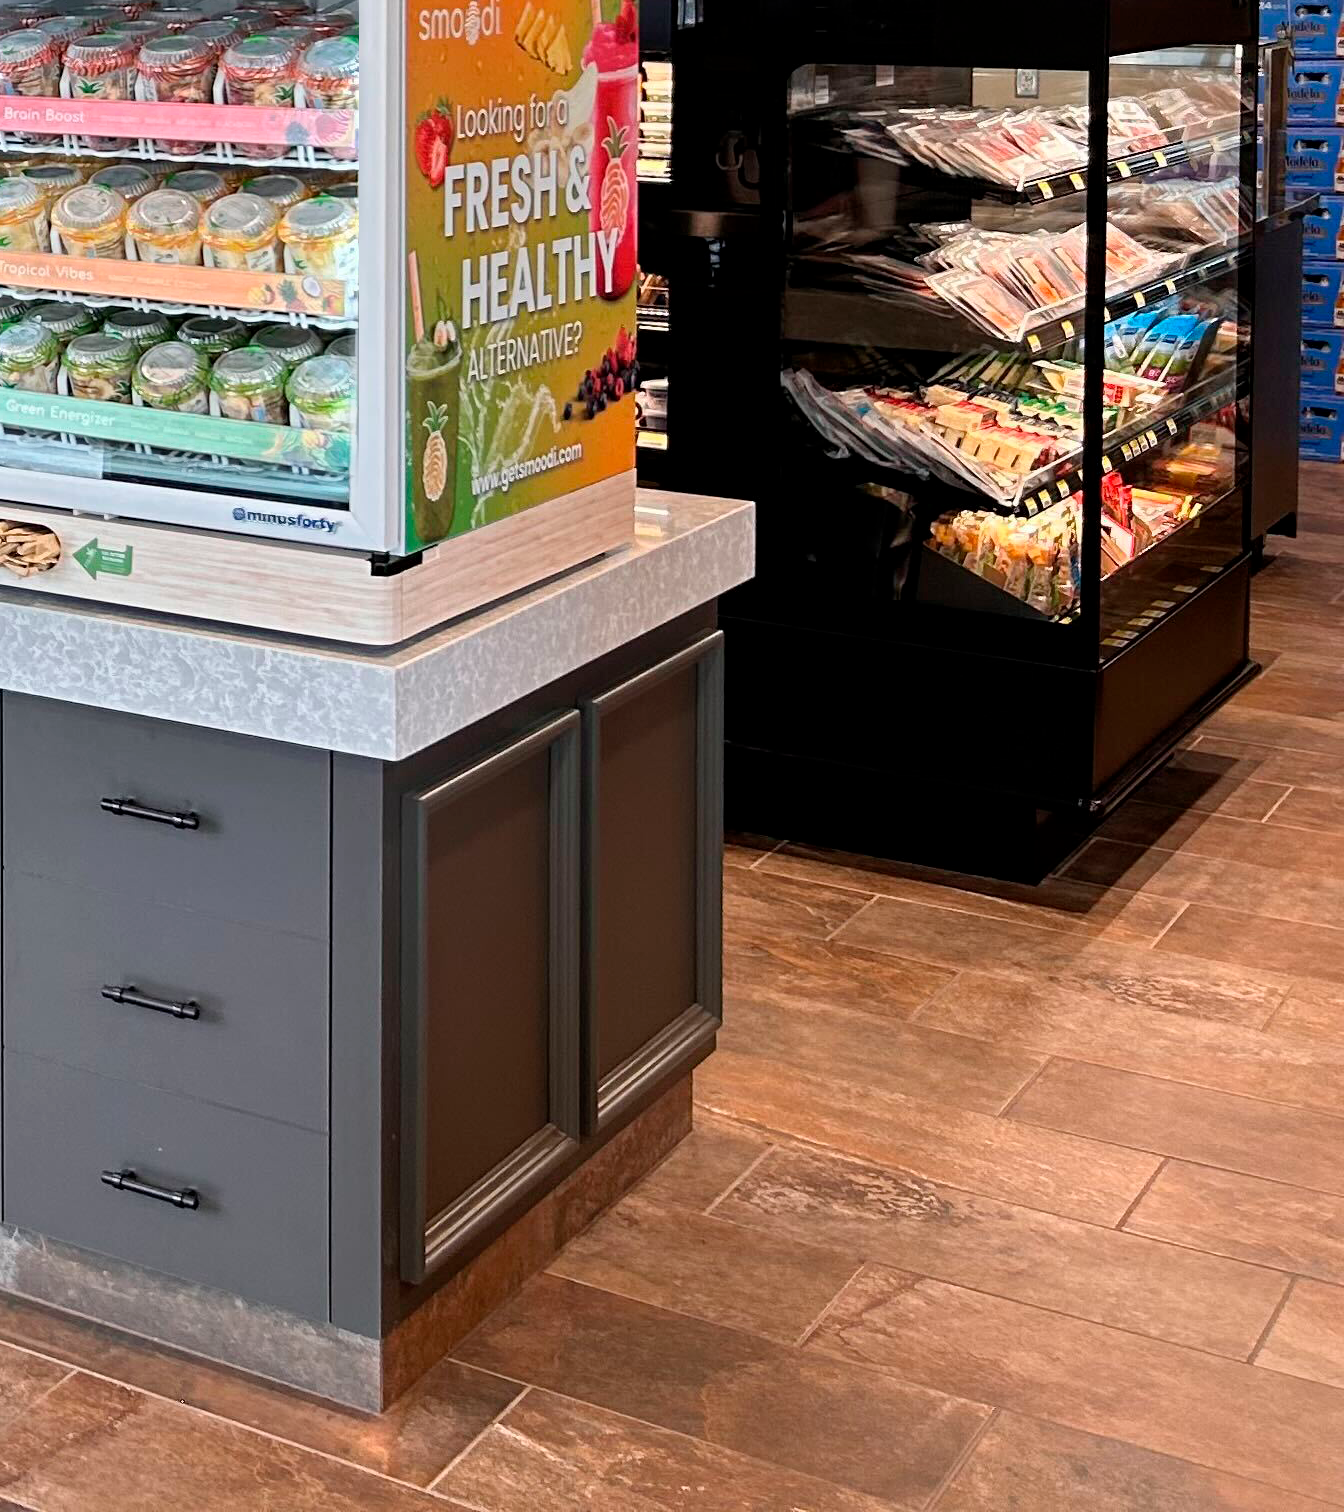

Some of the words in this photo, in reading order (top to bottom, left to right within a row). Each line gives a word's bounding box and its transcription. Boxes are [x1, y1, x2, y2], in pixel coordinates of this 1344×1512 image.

[3, 106, 41, 121] Brain
[45, 108, 85, 124] Boost
[456, 97, 525, 143] Looking
[529, 93, 554, 129] for
[555, 98, 569, 126] a
[443, 149, 558, 238] FRESH
[565, 144, 592, 214] &
[55, 263, 94, 282] Vibes
[461, 229, 621, 330] HEALTHY
[466, 320, 583, 384] ALTERNATIVE?
[5, 398, 45, 418] Green
[49, 404, 116, 427] Energizer
[471, 442, 583, 496] www.getsmoodi.com
[246, 509, 337, 534] minusforty
